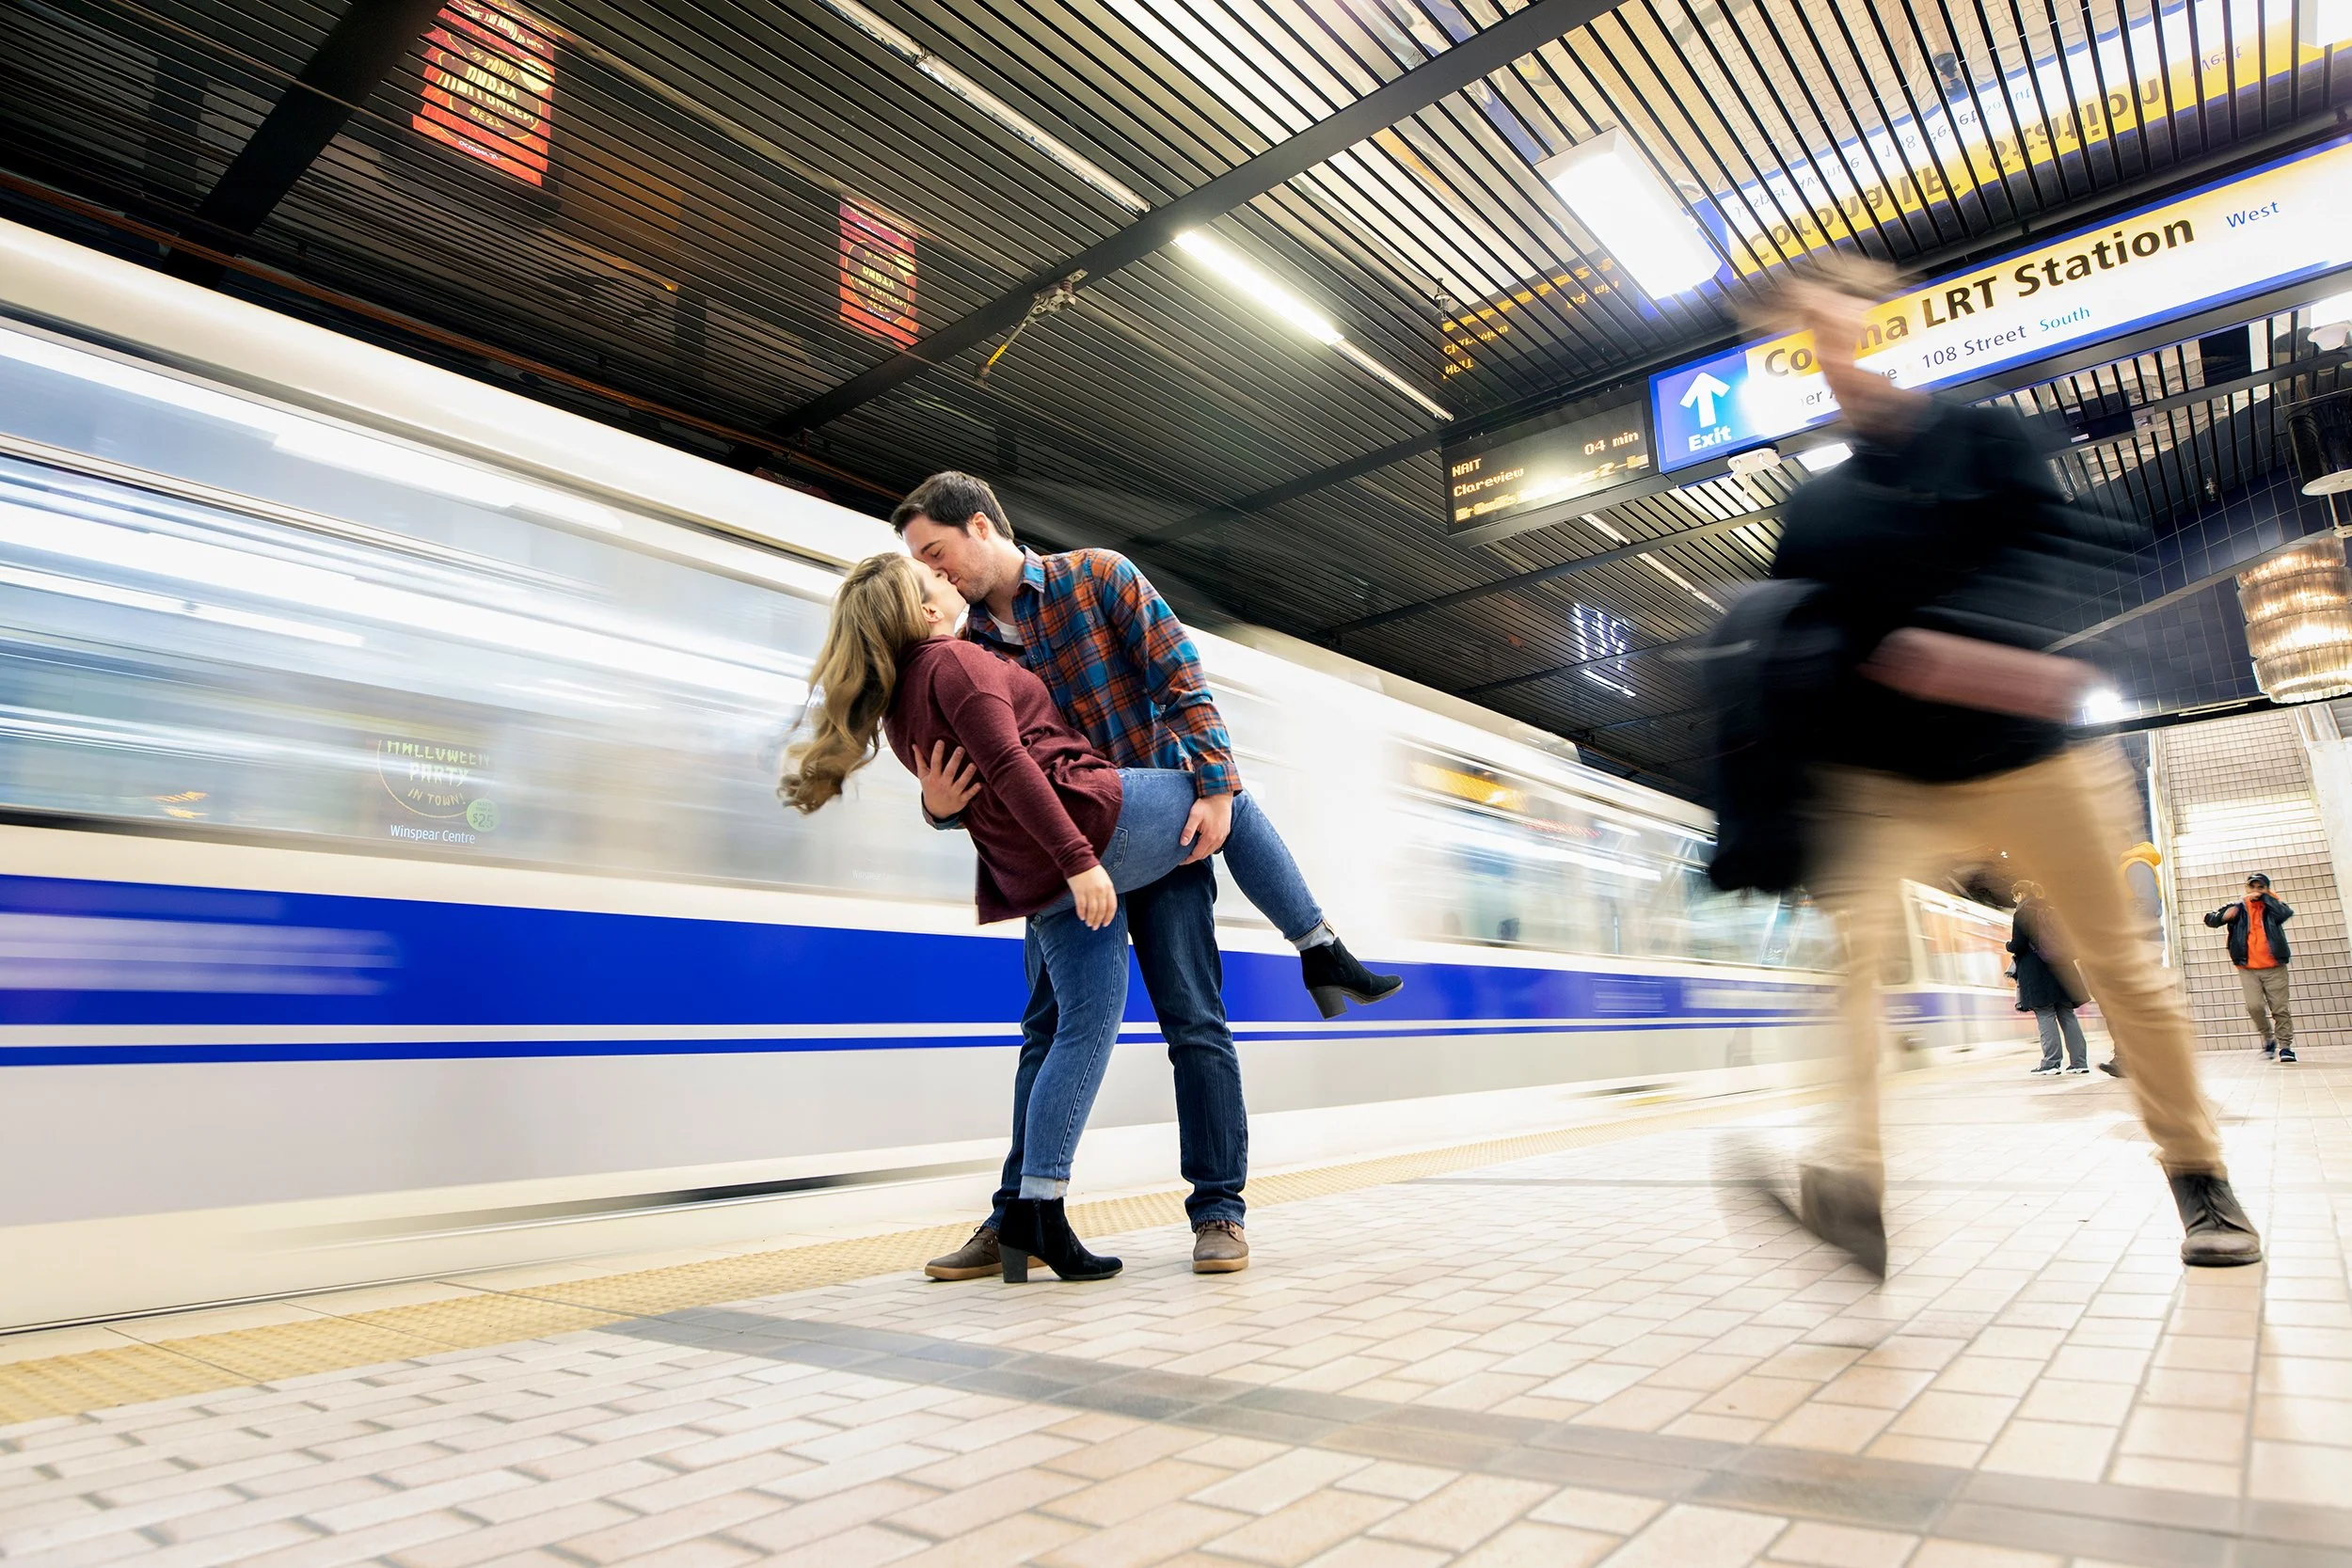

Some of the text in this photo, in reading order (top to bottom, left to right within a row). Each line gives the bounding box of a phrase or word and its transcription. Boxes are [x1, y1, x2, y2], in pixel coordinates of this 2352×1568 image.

[1765, 201, 2280, 377] Cona LRT Station West
[1922, 307, 2090, 368] 108 Street South
[1688, 425, 1732, 452] Exit
[1452, 432, 1639, 478] NAIT 04 min
[1454, 467, 1524, 497] Clareview
[408, 761, 470, 787] PARTY
[407, 787, 423, 801] IN
[427, 792, 466, 806] TOWN!
[472, 813, 494, 829] $25
[390, 825, 476, 845] Winspear Centre
